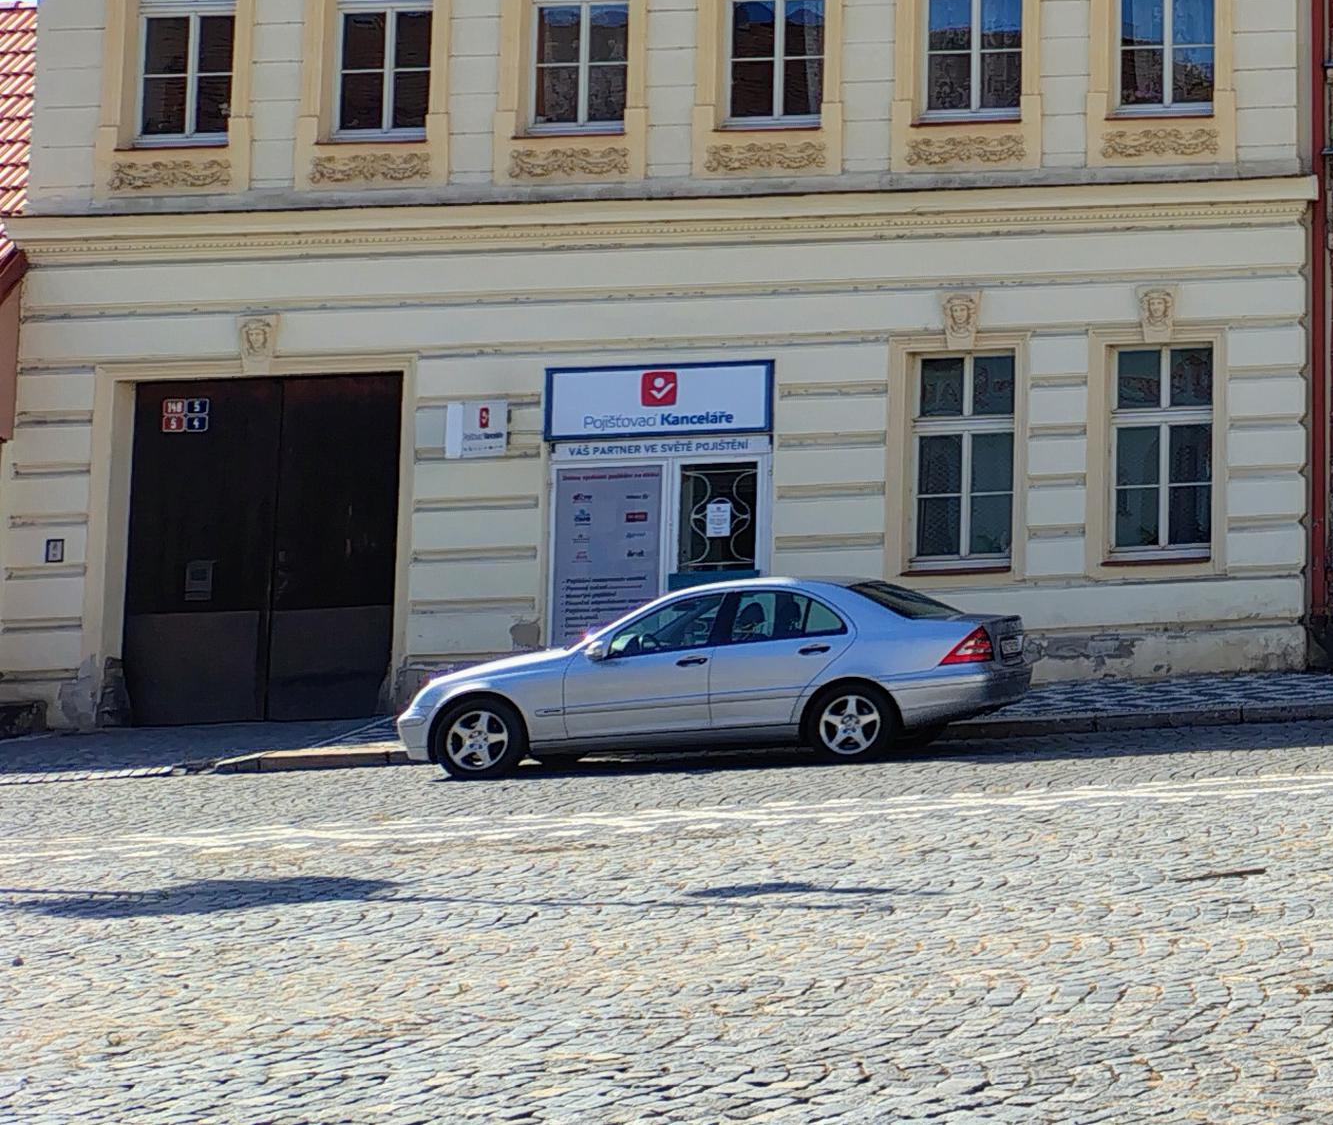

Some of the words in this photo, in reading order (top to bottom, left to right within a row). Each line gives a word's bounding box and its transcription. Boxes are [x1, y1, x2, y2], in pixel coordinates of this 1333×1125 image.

[583, 414, 656, 431] Pojišťovací
[660, 411, 734, 426] Kanceláře
[568, 445, 590, 456] VÁŠ
[593, 442, 641, 455] PARTNER
[644, 444, 658, 453] VE
[696, 438, 749, 451] POJIŠTĚNÍ
